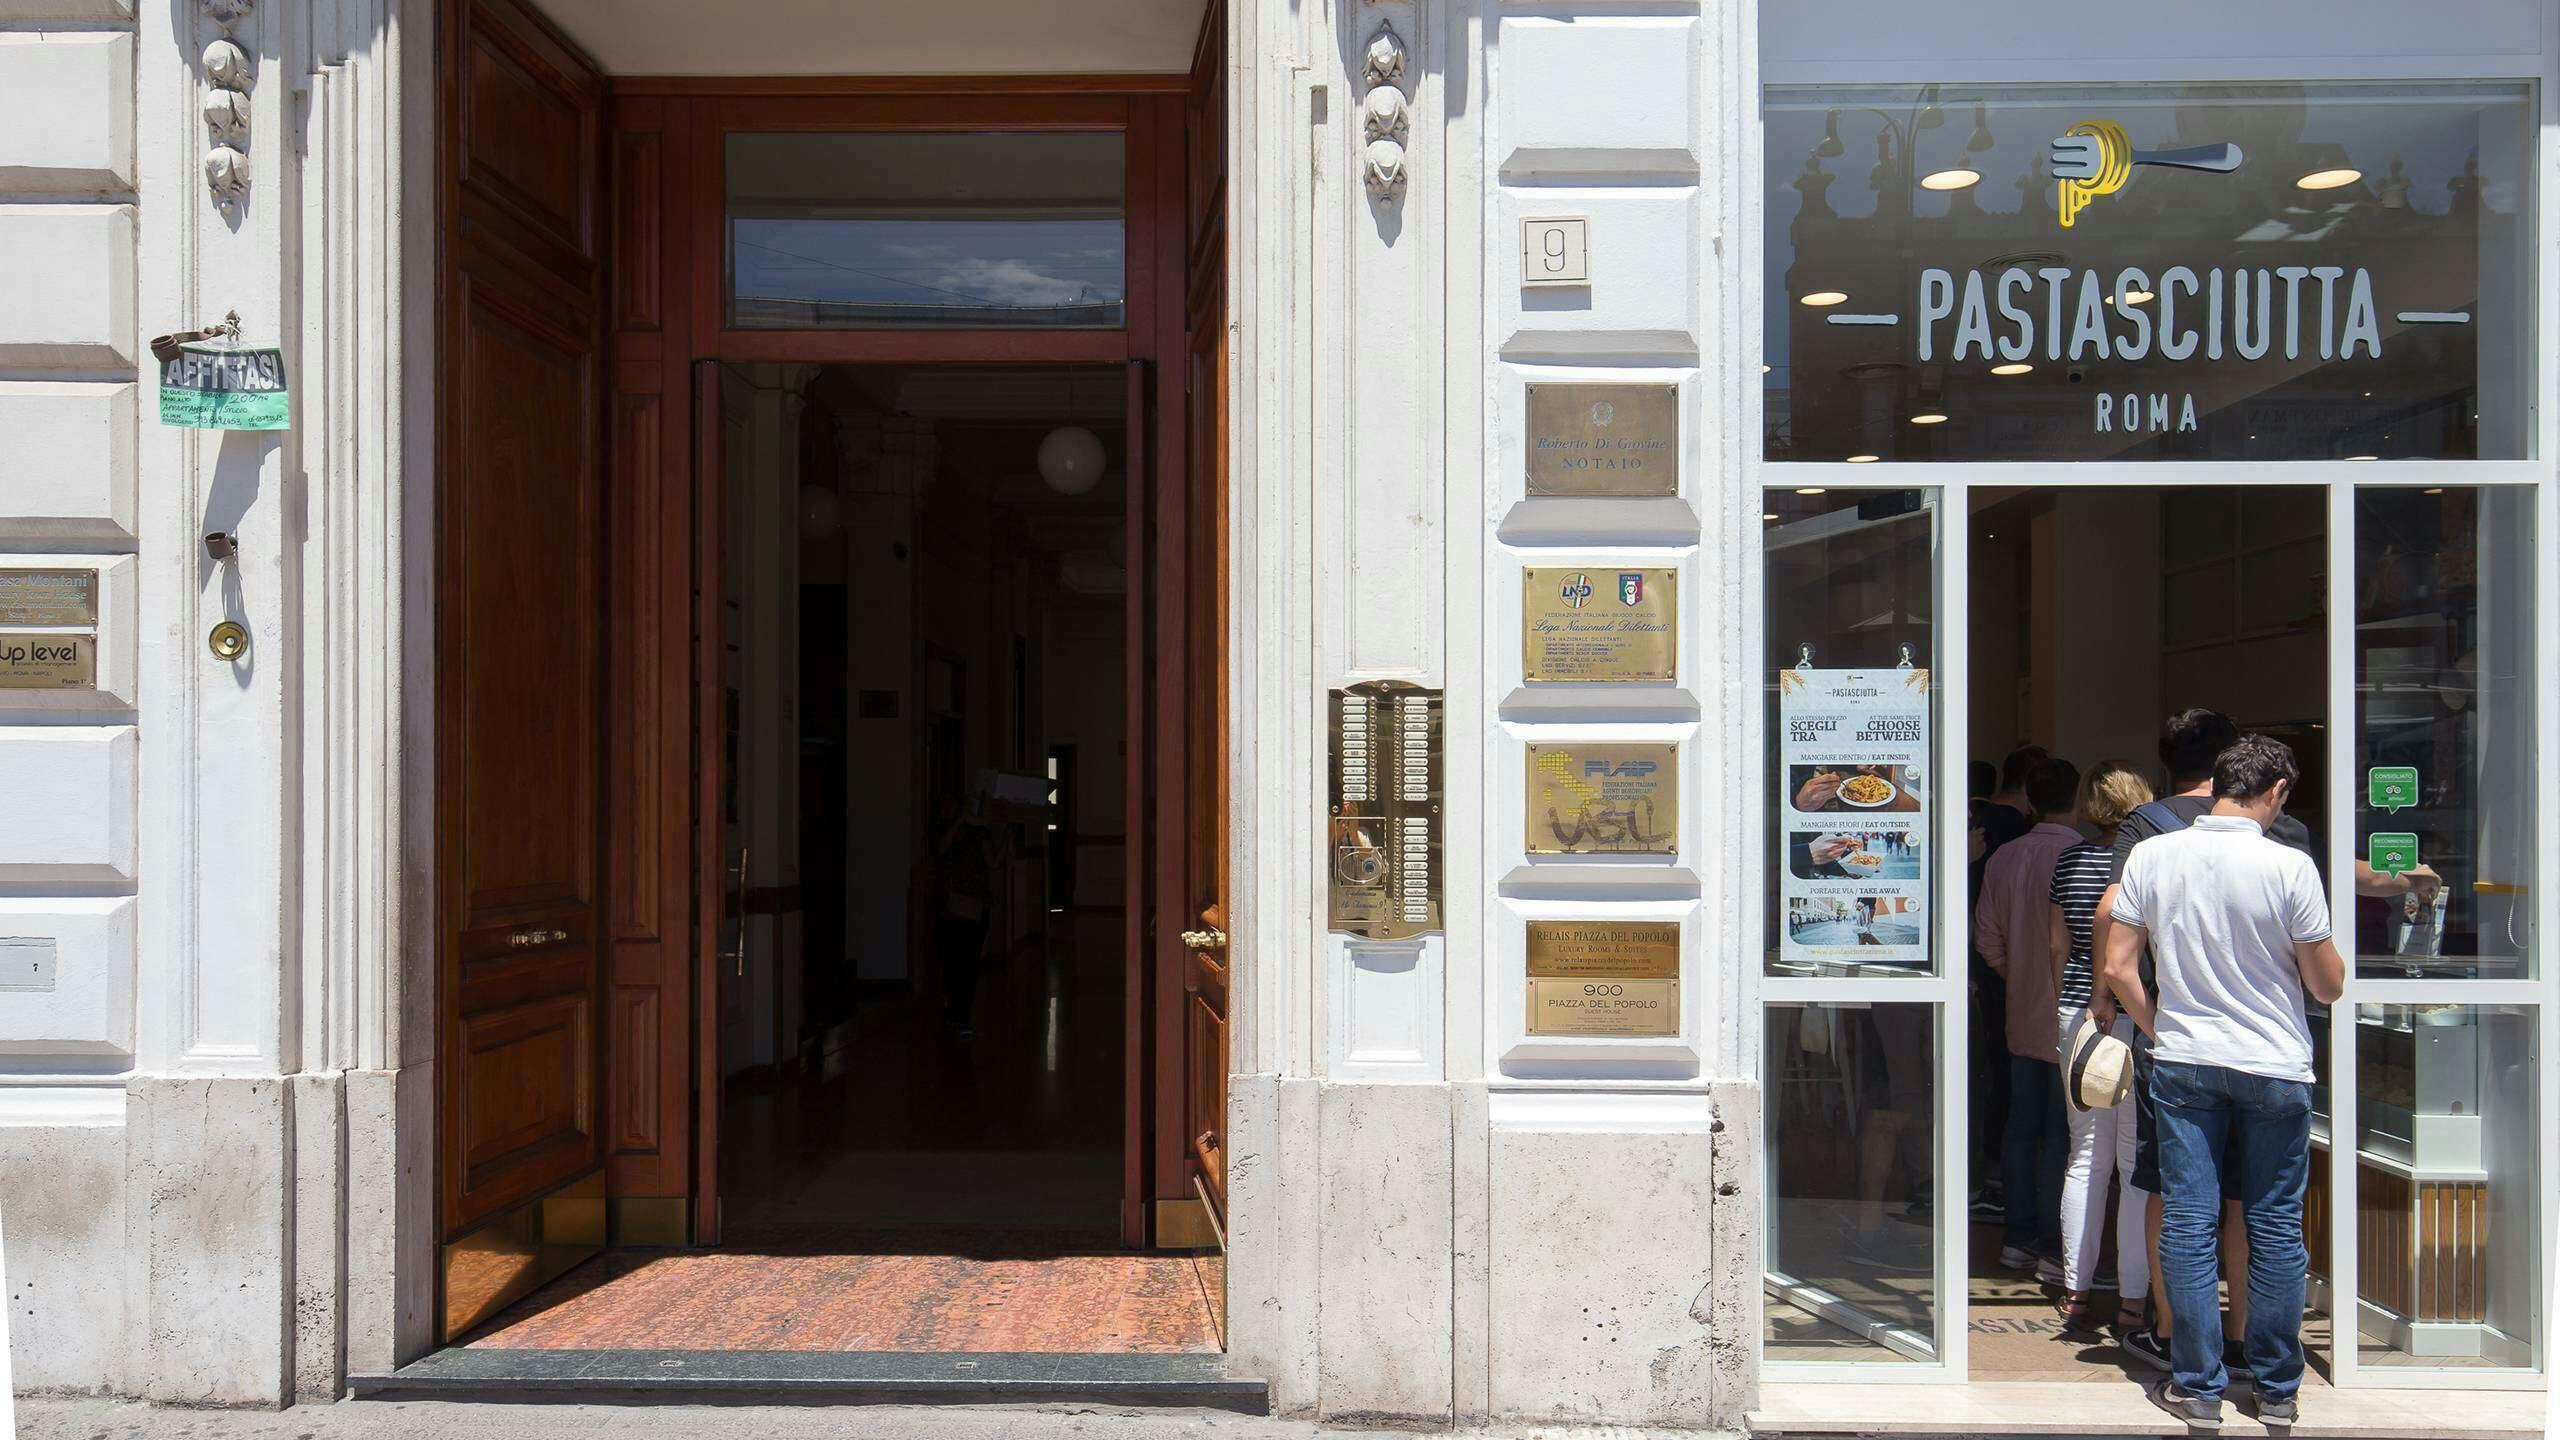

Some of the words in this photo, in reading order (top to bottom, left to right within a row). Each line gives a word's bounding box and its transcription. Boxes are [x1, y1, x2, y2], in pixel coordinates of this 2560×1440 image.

[1544, 229, 1566, 272] 9
[1919, 265, 2382, 361] PASTASCIUTTA
[2095, 393, 2197, 432] ROMA
[1537, 437, 1588, 449] Roberto
[1595, 437, 1612, 449] Di
[1562, 457, 1642, 469] NOTAIO
[1562, 584, 1592, 598] LND
[1534, 619, 1560, 634] Lega
[1562, 620, 1615, 632] Nazionale
[1618, 620, 1670, 632] Dilettanti
[31, 641, 77, 661] level
[1832, 688, 1878, 698] PASTASCIUTTA
[1790, 721, 1837, 731] SCEGLI
[1867, 721, 1921, 731] CHOOSE
[1790, 731, 1817, 742] TRA
[1856, 731, 1921, 742] BETWEEN
[1537, 931, 1570, 941] RELAIS
[1574, 931, 1607, 942] PIAZZA
[1611, 932, 1628, 942] DEL
[1632, 932, 1670, 943] POPOLO
[1583, 984, 1623, 997] 900
[1548, 1000, 1585, 1008] PIAZZA
[1590, 1000, 1610, 1008] DEL
[1614, 1000, 1658, 1009] POPOLO
